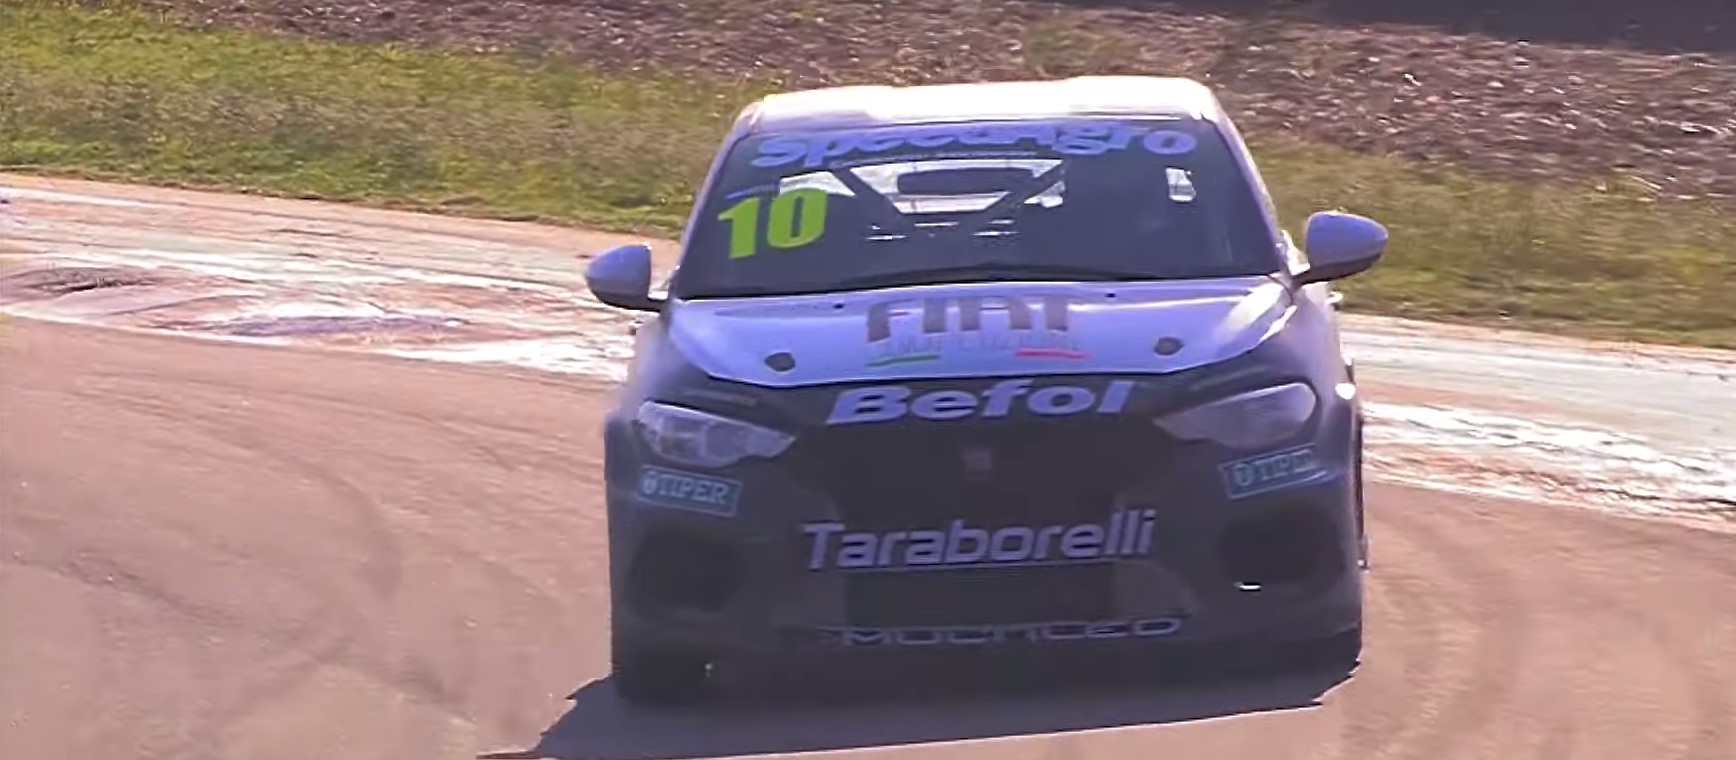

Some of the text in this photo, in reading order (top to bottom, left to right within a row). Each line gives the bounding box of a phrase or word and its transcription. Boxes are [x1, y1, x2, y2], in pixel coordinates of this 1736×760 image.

[717, 187, 828, 260] 10
[865, 296, 1069, 342] FIAT
[826, 379, 1137, 426] Befol
[657, 472, 731, 505] TIPER
[803, 509, 1158, 570] Taraborelli
